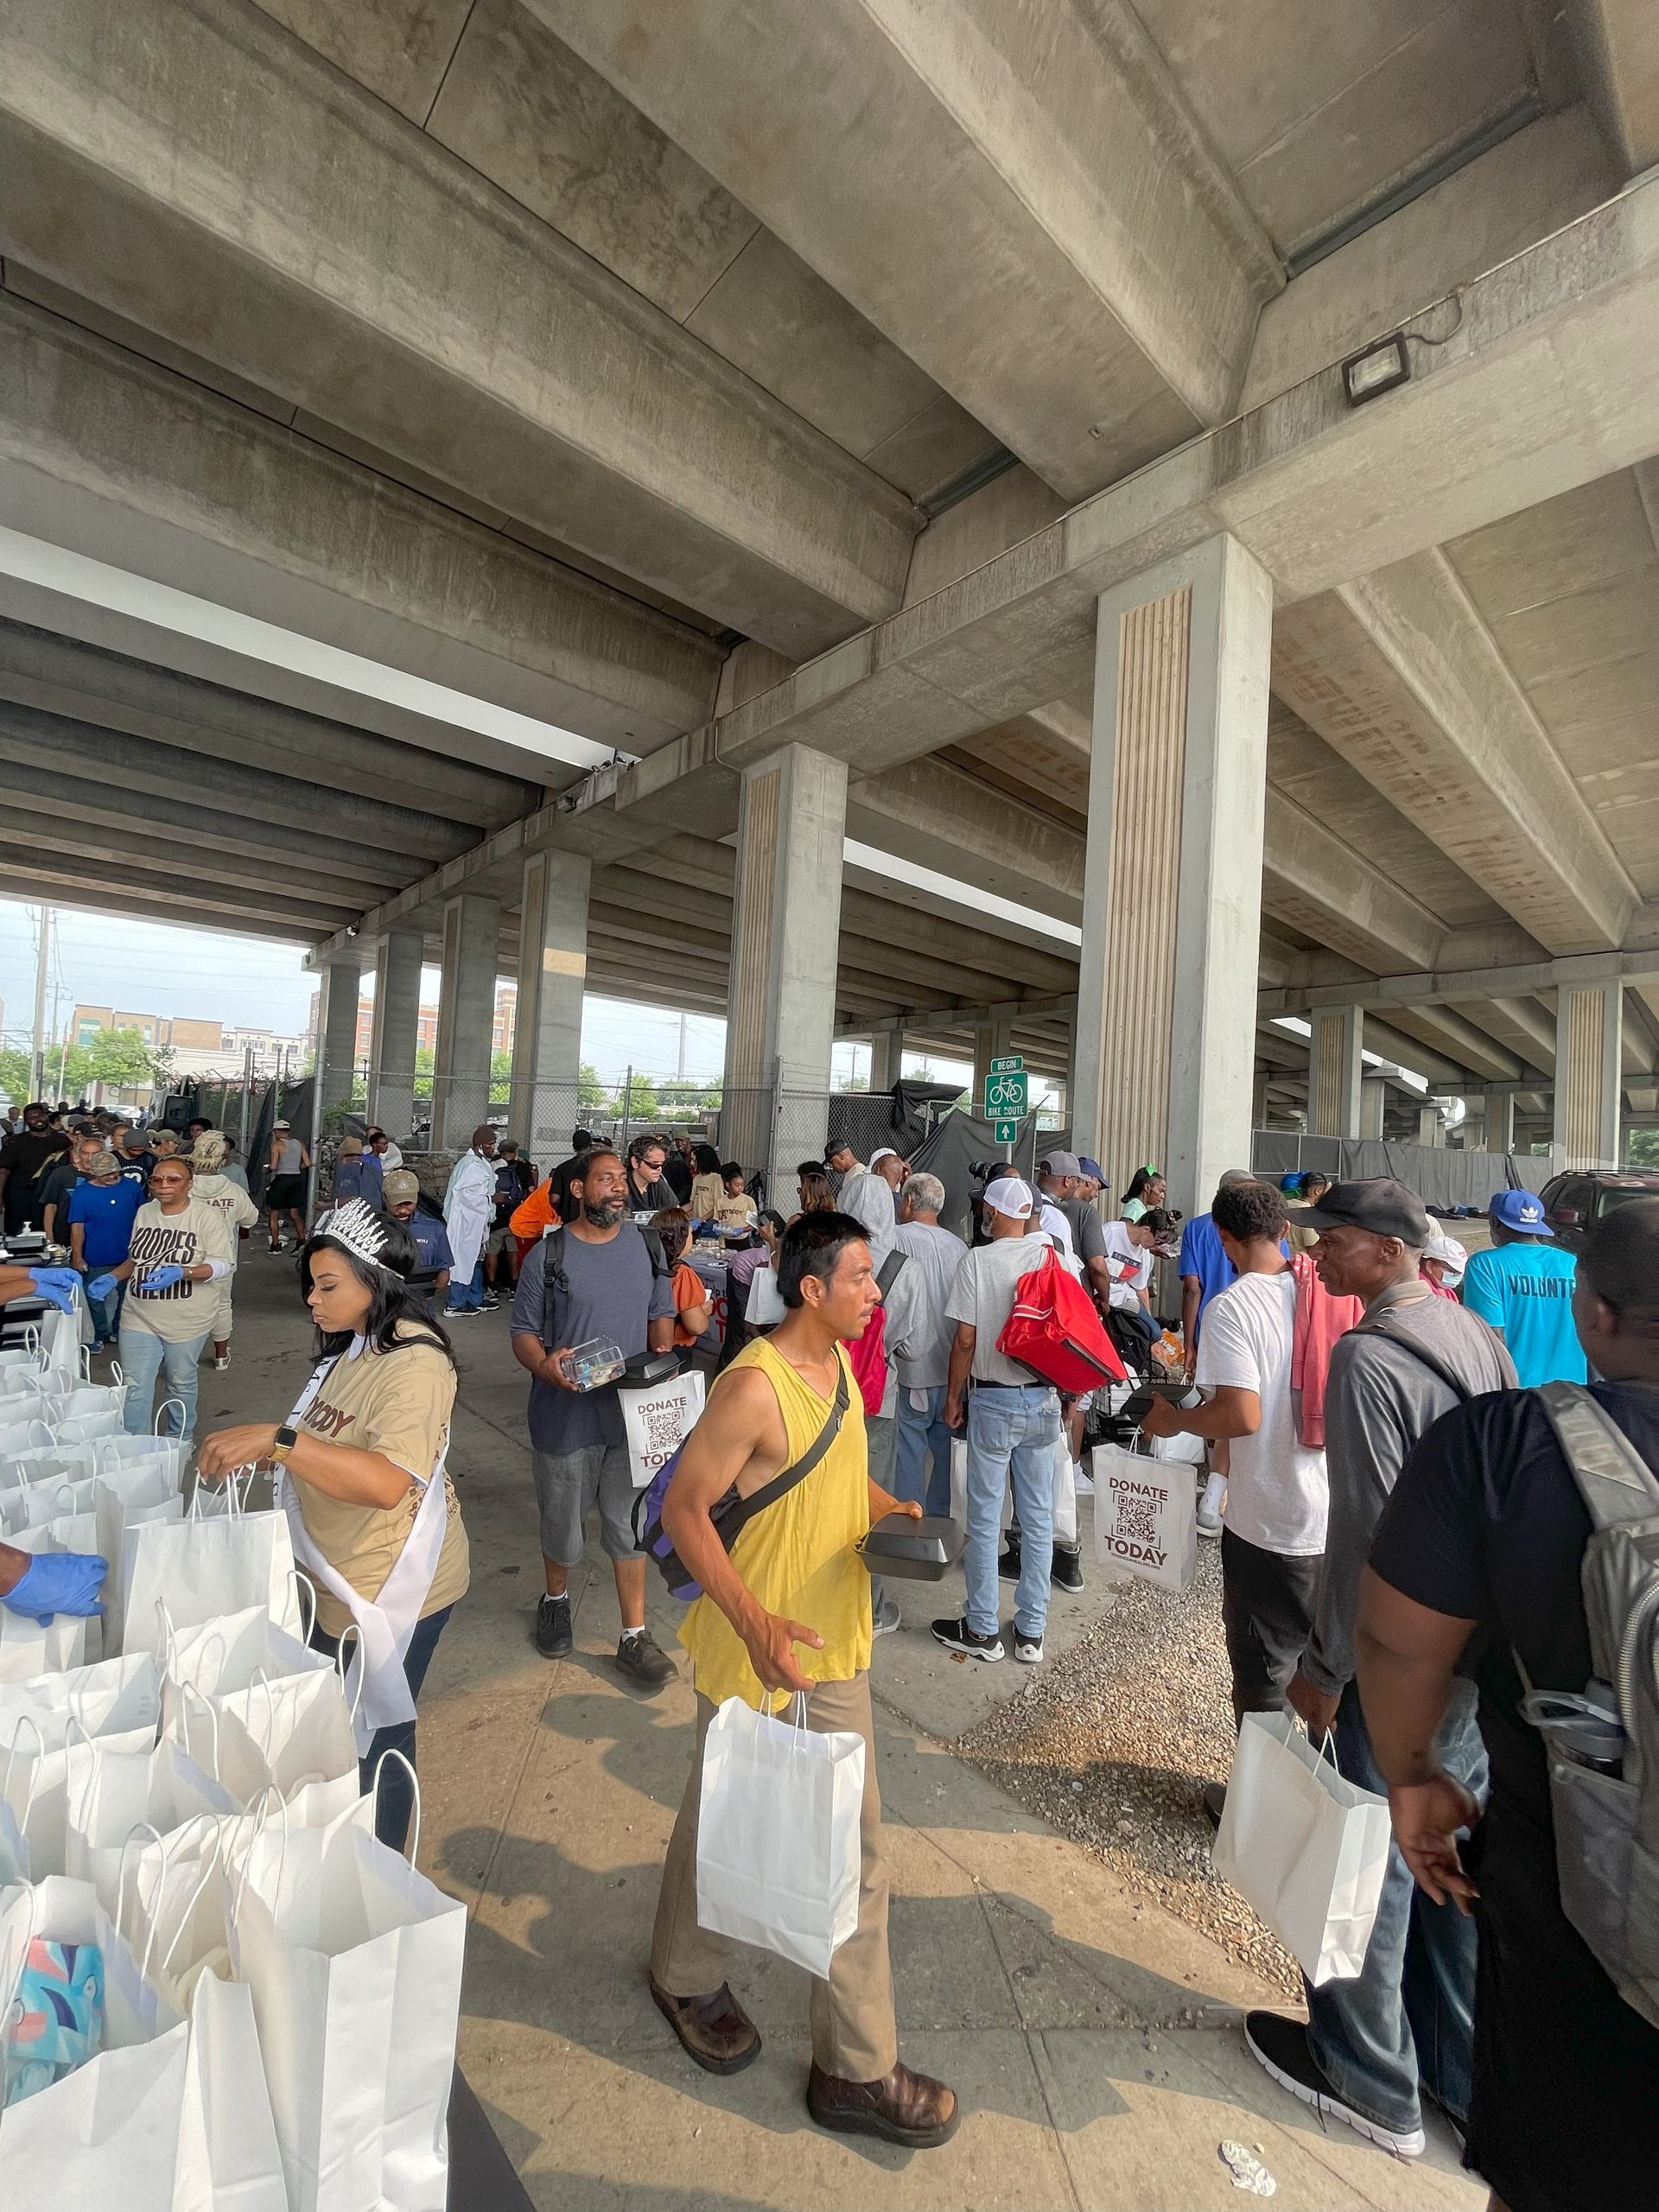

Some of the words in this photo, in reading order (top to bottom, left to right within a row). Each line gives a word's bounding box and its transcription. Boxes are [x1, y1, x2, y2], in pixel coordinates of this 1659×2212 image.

[997, 1059, 1017, 1071] BEGIN
[988, 1107, 1001, 1116] BIKE
[1004, 1105, 1024, 1116] ROUTE
[638, 1396, 687, 1414] DONATE
[640, 1452, 674, 1467] TOD
[1109, 1477, 1168, 1501] DONATE
[1104, 1535, 1168, 1566] TODAY
